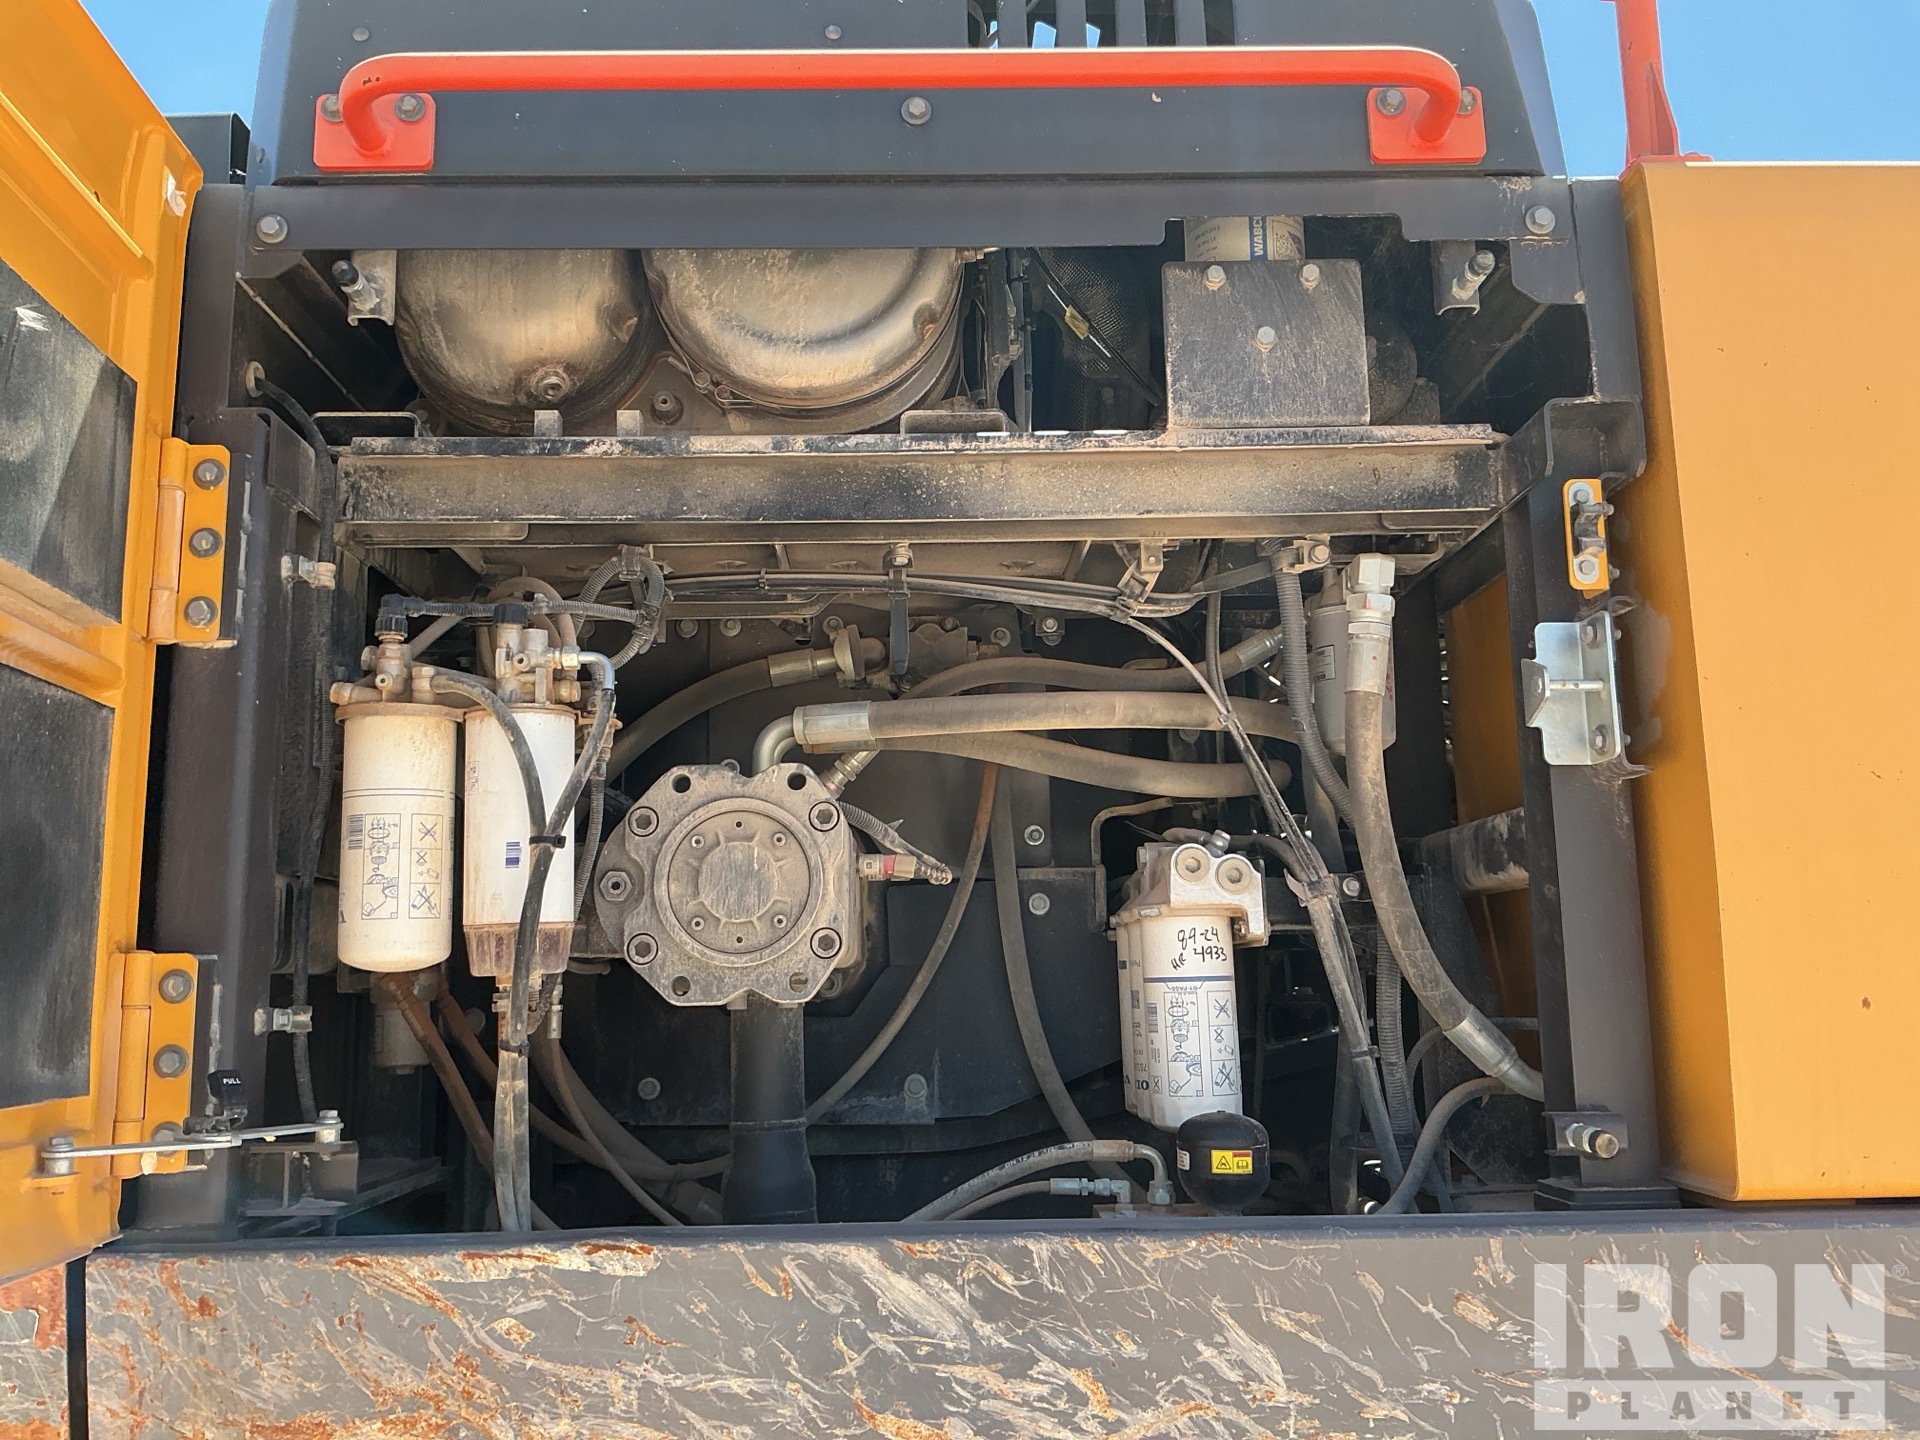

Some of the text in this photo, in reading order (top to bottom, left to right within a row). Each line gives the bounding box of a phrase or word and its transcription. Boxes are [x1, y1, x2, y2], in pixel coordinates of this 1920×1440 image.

[1193, 946, 1227, 962] 4933
[223, 1077, 241, 1085] PULL
[1004, 1160, 1017, 1169] DN
